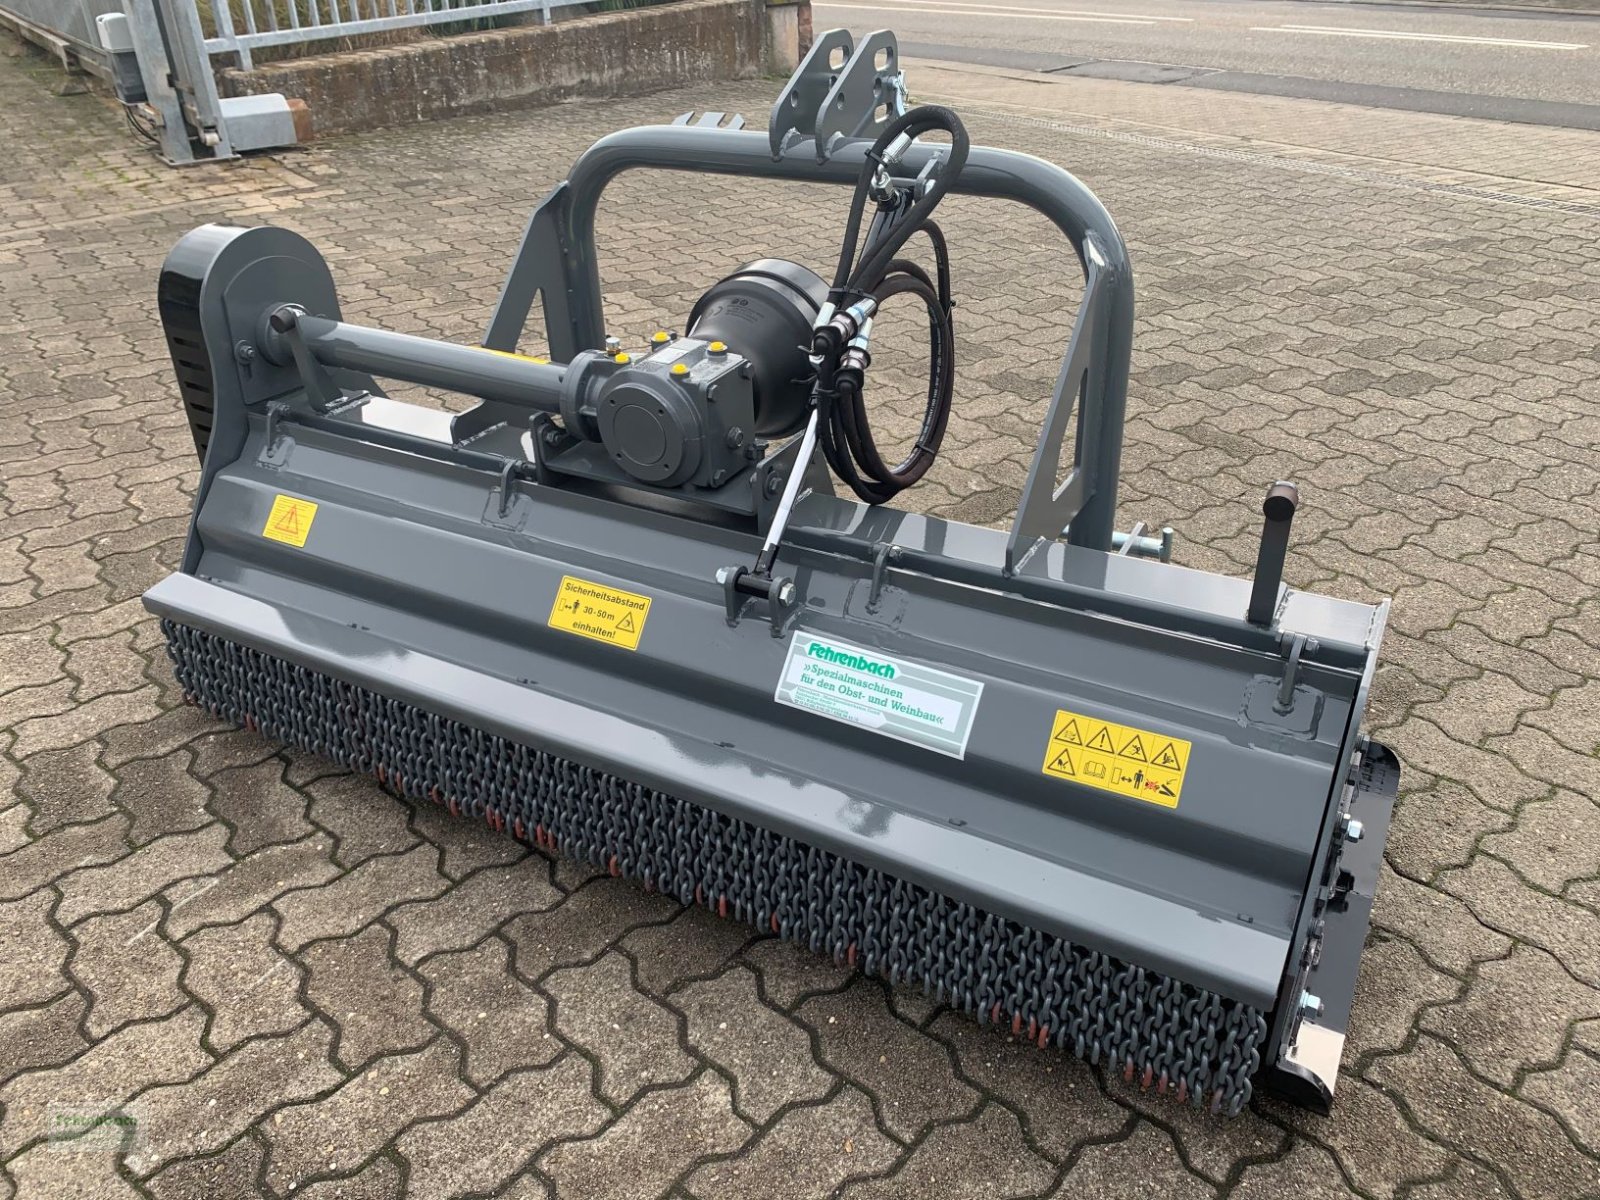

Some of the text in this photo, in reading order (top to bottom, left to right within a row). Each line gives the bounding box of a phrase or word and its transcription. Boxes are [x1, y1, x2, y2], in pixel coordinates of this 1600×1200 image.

[565, 582, 645, 611] Sicherheitsabstand
[572, 621, 616, 639] einhalten!
[807, 642, 895, 679] Fehrenbach
[800, 672, 815, 685] für
[816, 677, 836, 693] den
[838, 684, 866, 699] Obst-
[867, 693, 888, 708] und
